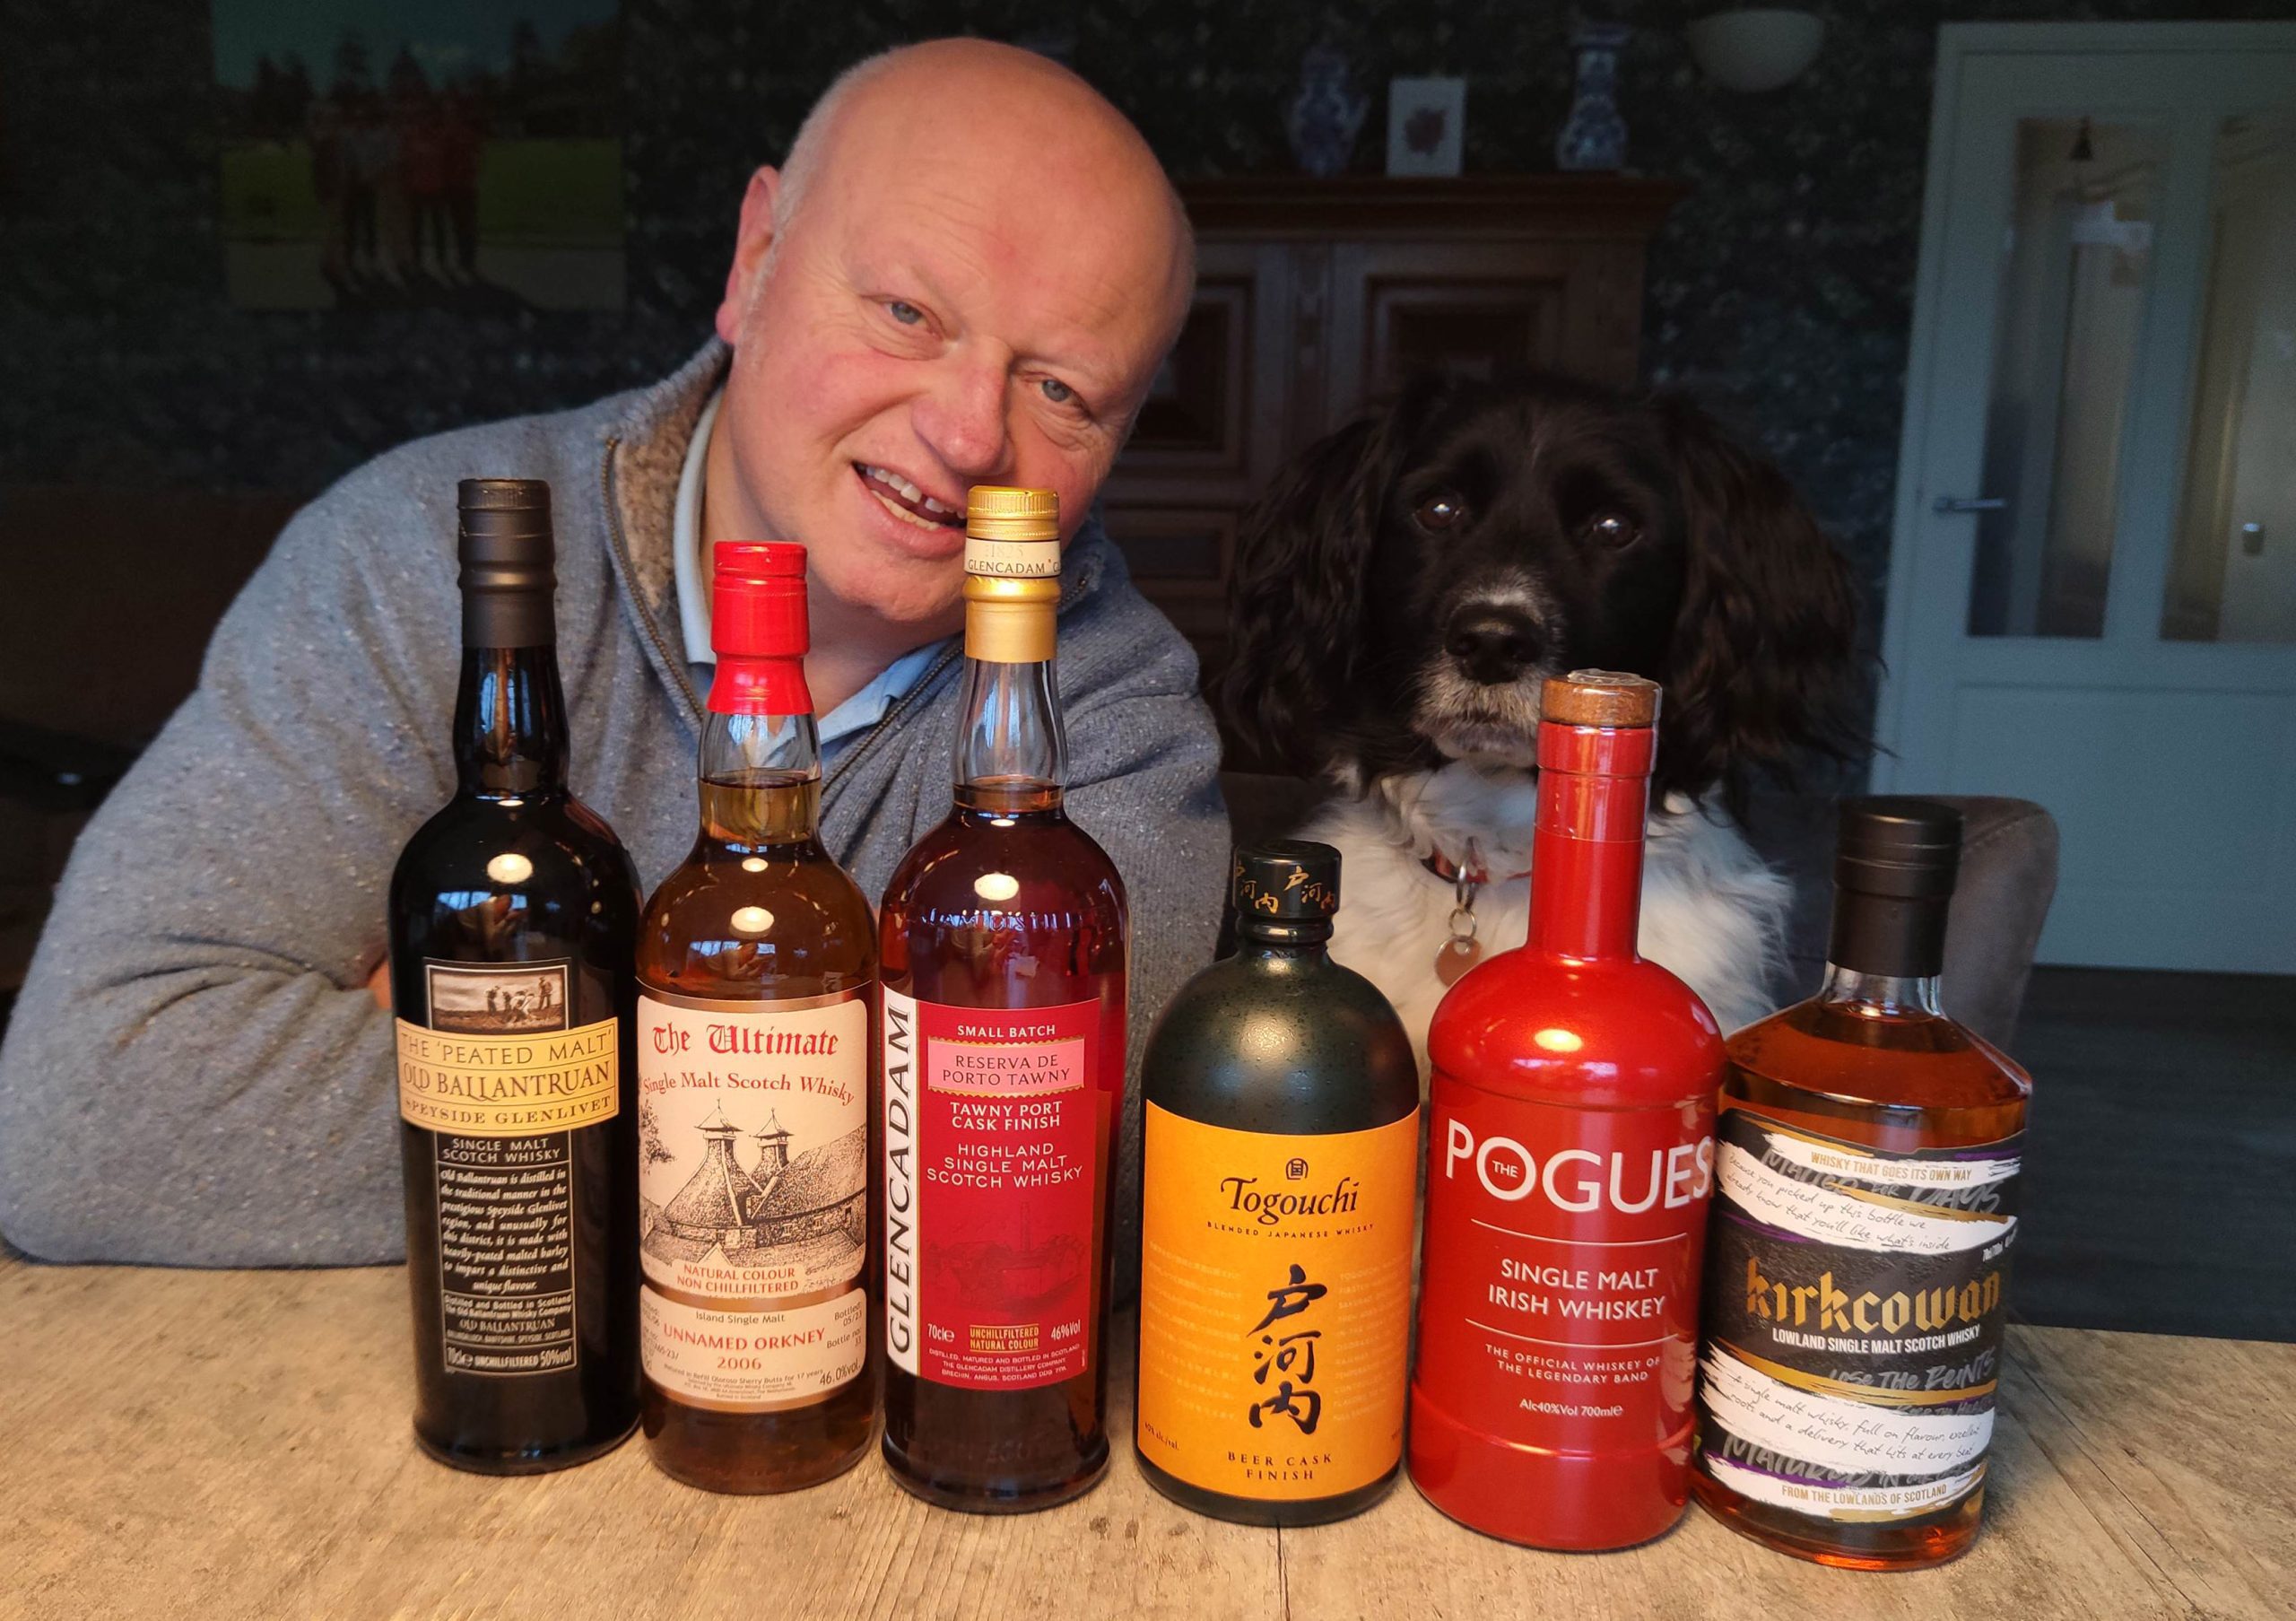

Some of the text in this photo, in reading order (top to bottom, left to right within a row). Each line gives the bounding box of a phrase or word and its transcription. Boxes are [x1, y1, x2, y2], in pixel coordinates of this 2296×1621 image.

[969, 559, 1045, 573] GLENCADAM
[652, 1021, 839, 1056] The Ultimate
[957, 1024, 1056, 1038] SMALL BATCH
[402, 1029, 612, 1064] THE 'PEATED MALT'
[956, 1054, 1058, 1070] RESERVA DE
[404, 1060, 611, 1102] OLD BALLANTRUAN
[943, 1068, 1070, 1085] PORTO TAWNY
[642, 1071, 855, 1106] Single Malt Scotch Whisky
[405, 1095, 611, 1124] SPEYSIDE GLENLIVET
[950, 1101, 1062, 1117] TAWNY PORT
[952, 1116, 1060, 1130] CASK FINISH
[453, 1137, 549, 1151] SINGLE MALT
[958, 1143, 1054, 1158] HIGHLAND
[443, 1148, 561, 1163] SCOTCH WHISKY
[944, 1155, 1067, 1173] SINGLE MALT
[1446, 1118, 1712, 1214] POGUES
[1492, 1160, 1519, 1178] THE
[1811, 1151, 1972, 1181] WHISKY THAT GOES ITS OWN WAY
[520, 1170, 555, 1183] distilled
[557, 1169, 566, 1180] in
[887, 1003, 911, 1353] GLENCADAM
[926, 1165, 1083, 1189] SCOTCH WHISKY
[502, 1191, 538, 1199] manner
[541, 1186, 550, 1198] in
[552, 1183, 567, 1196] the
[1220, 1177, 1360, 1225] Togouchi
[1758, 1175, 1773, 1188] you
[1776, 1183, 1818, 1204] picked
[1819, 1201, 1834, 1213] up
[1841, 1200, 1863, 1218] this
[1867, 1209, 1904, 1227] bottle
[475, 1219, 494, 1231] and
[550, 1215, 568, 1228] for
[1756, 1191, 1950, 1250] know that like what's inside
[547, 1228, 568, 1242] with
[1207, 1221, 1374, 1239] BLENDED JAPANESE WHISKY
[540, 1244, 569, 1259] barley
[498, 1264, 547, 1277] distinctive
[550, 1258, 569, 1273] and
[683, 1264, 796, 1281] NATURAL COLOUR
[1501, 1259, 1658, 1290] SINGLE MALT
[676, 1275, 799, 1294] NON CHILLFILTERED
[1489, 1285, 1665, 1320] IRISH WHISKEY
[1747, 1256, 2000, 1335] kirkcowan
[459, 1318, 555, 1332] OLD BALLANTRUAN
[695, 1311, 786, 1325] Island Single Malt
[663, 1322, 748, 1351] UNNAMED
[754, 1327, 825, 1351] ORKNEY
[826, 1333, 850, 1348] Bottle
[970, 1327, 1039, 1339] UNCHILLFILTERED
[1772, 1323, 1981, 1355] LOWLAND SINGLE MALT SCOTCH WHISKY
[970, 1338, 1039, 1350] NATURAL COLOUR
[717, 1356, 762, 1370] 2006
[962, 1355, 994, 1364] MATURED
[996, 1356, 1011, 1364] AND
[1013, 1355, 1040, 1364] BOTTLED
[1485, 1343, 1661, 1371] THE OFFICIAL WHISKEY OF
[739, 1377, 762, 1386] Sherry
[796, 1373, 804, 1381] 17
[1498, 1360, 1648, 1383] THE LEGENDARY BAND
[1744, 1381, 1770, 1404] single
[1775, 1401, 1806, 1415] malt
[1853, 1419, 1883, 1436] full
[1759, 1411, 1786, 1425] and
[1798, 1425, 1849, 1449] delivery
[1854, 1440, 1883, 1455] that
[1886, 1443, 1906, 1459] hits
[1912, 1447, 1926, 1460] at
[1928, 1451, 1952, 1461] every
[1228, 1451, 1332, 1466] BEER CASK
[1246, 1468, 1314, 1480] FINISH
[1781, 1484, 1947, 1505] FROM THE LOWLANDS OF SCOTLAND
